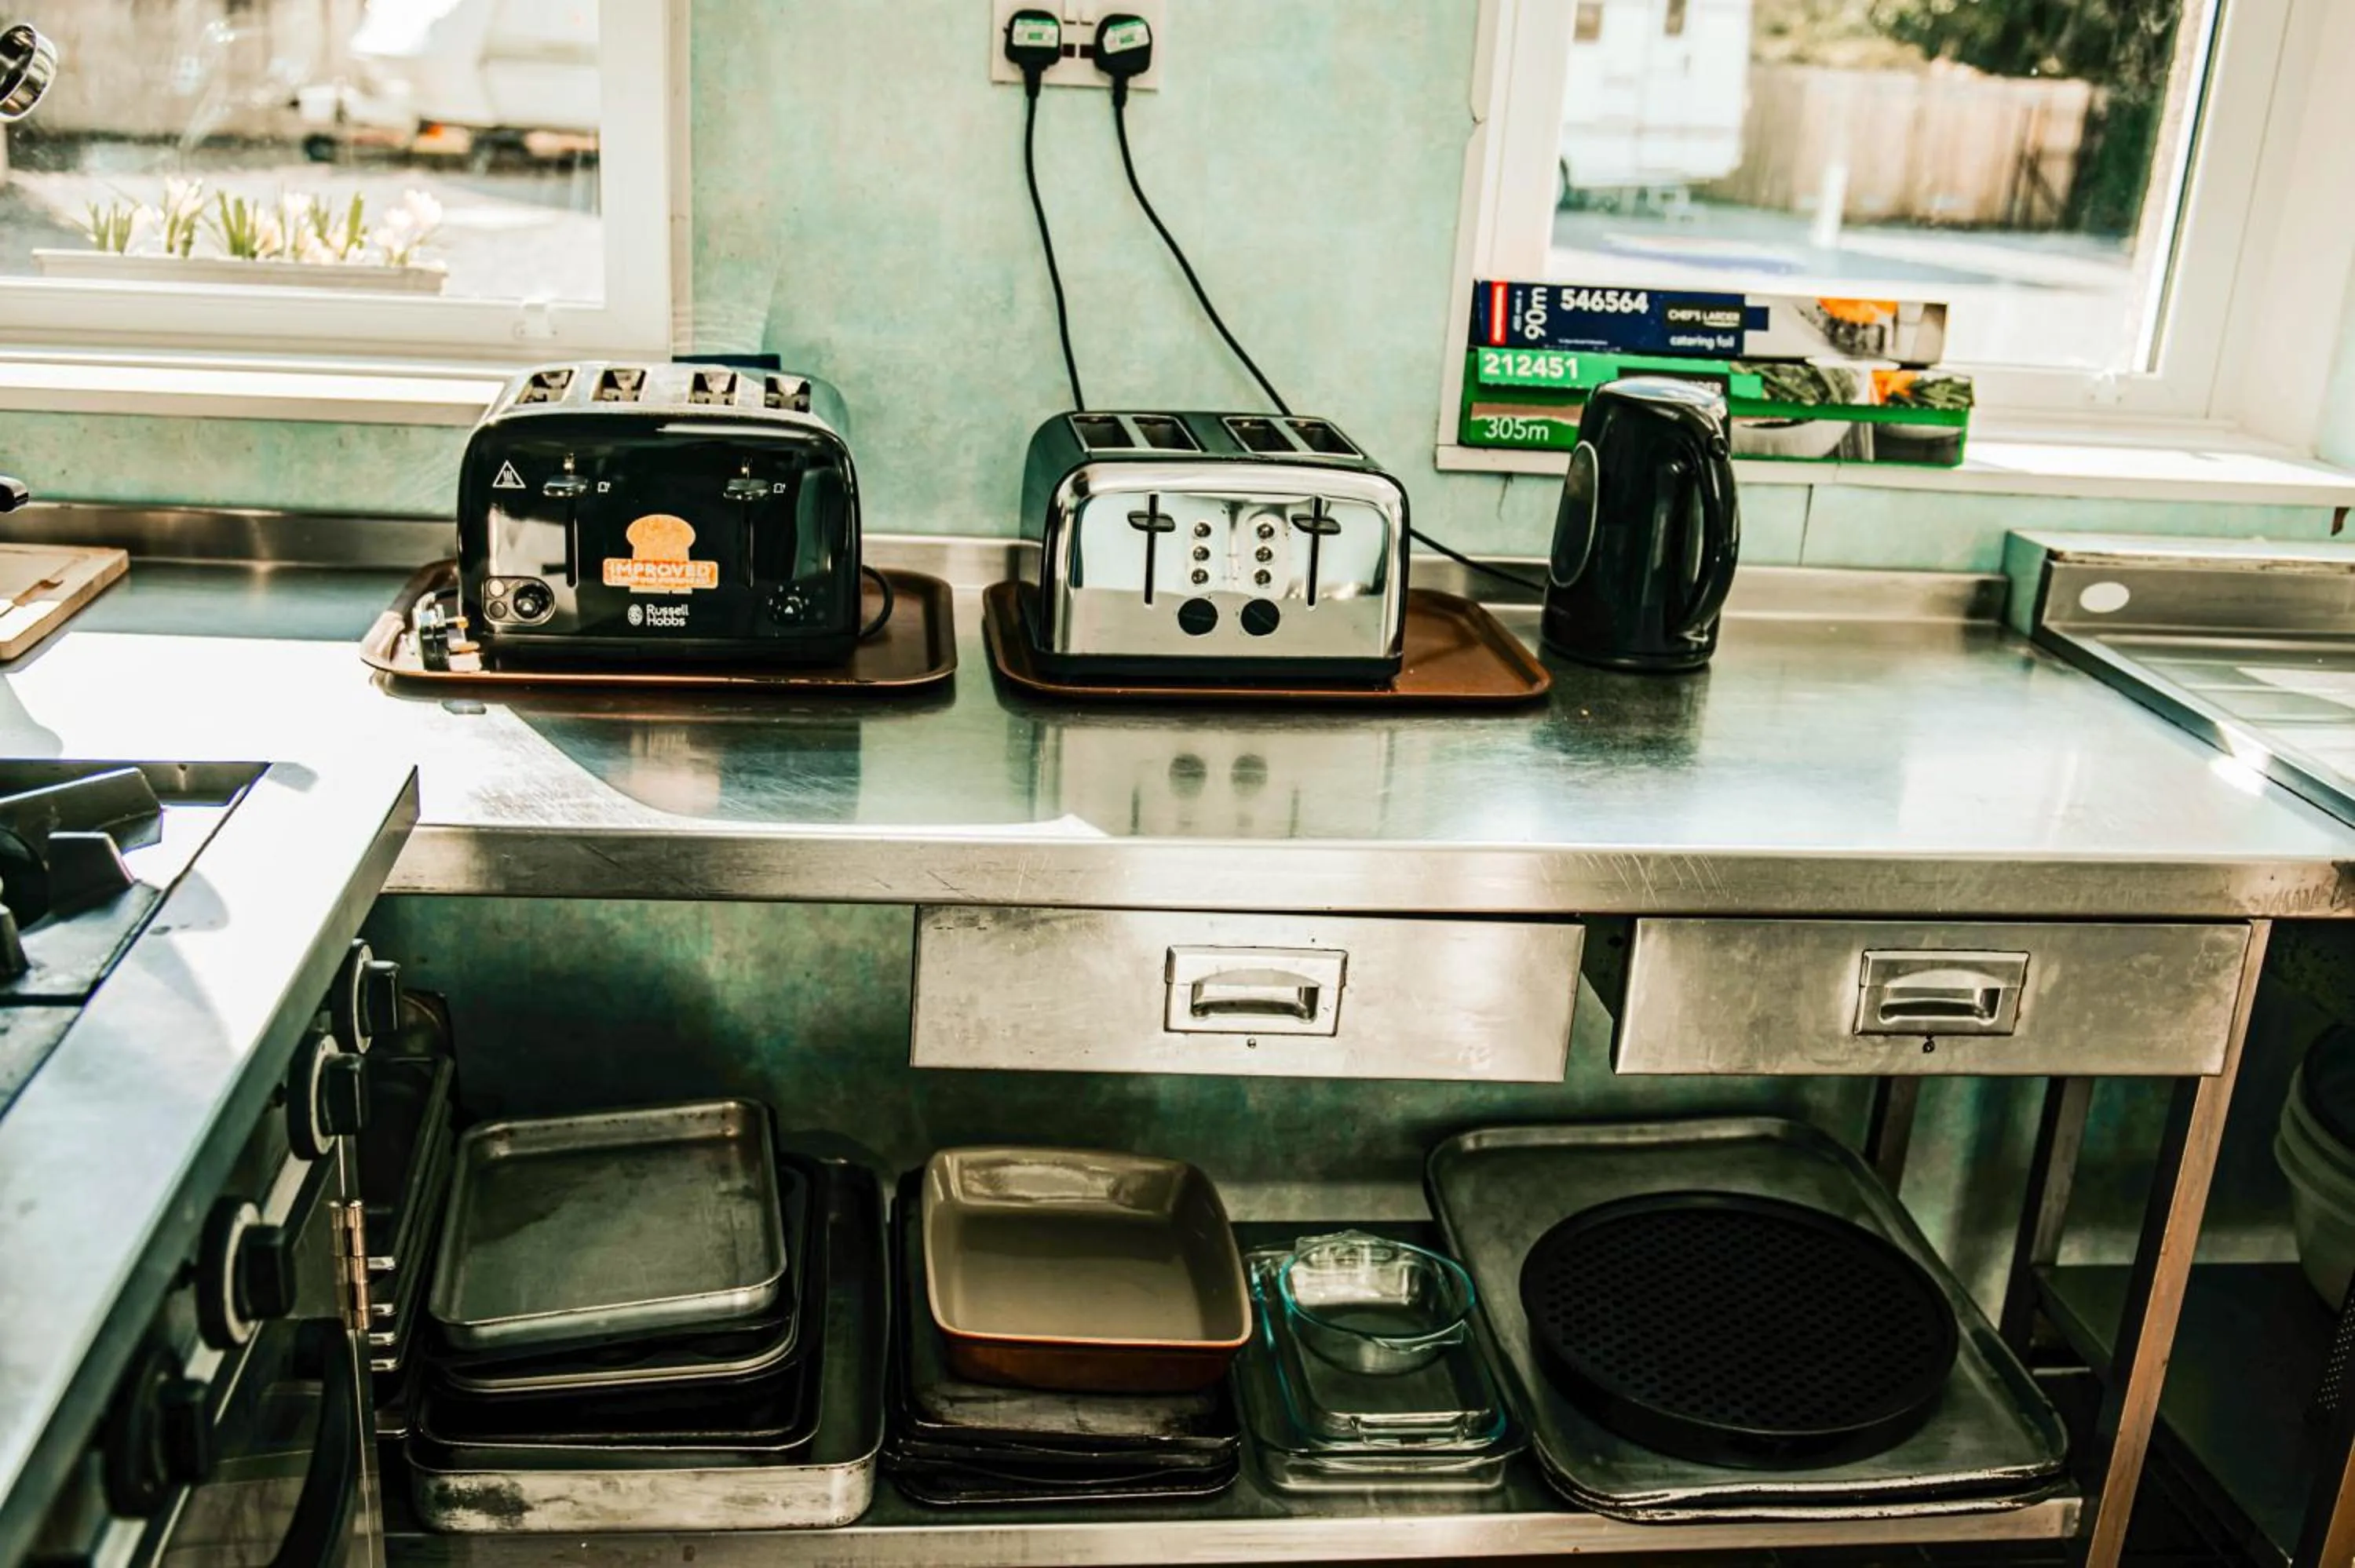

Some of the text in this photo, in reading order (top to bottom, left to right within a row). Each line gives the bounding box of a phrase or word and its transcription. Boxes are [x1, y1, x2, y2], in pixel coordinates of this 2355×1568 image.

[1560, 288, 1648, 314] 546564
[1524, 286, 1547, 340] 90m
[1669, 335, 1714, 351] catering
[1483, 352, 1578, 380] 212451
[1484, 416, 1550, 440] 305m
[610, 562, 710, 578] IMPROVED
[646, 603, 689, 616] Russell
[646, 614, 686, 626] Hobbs
